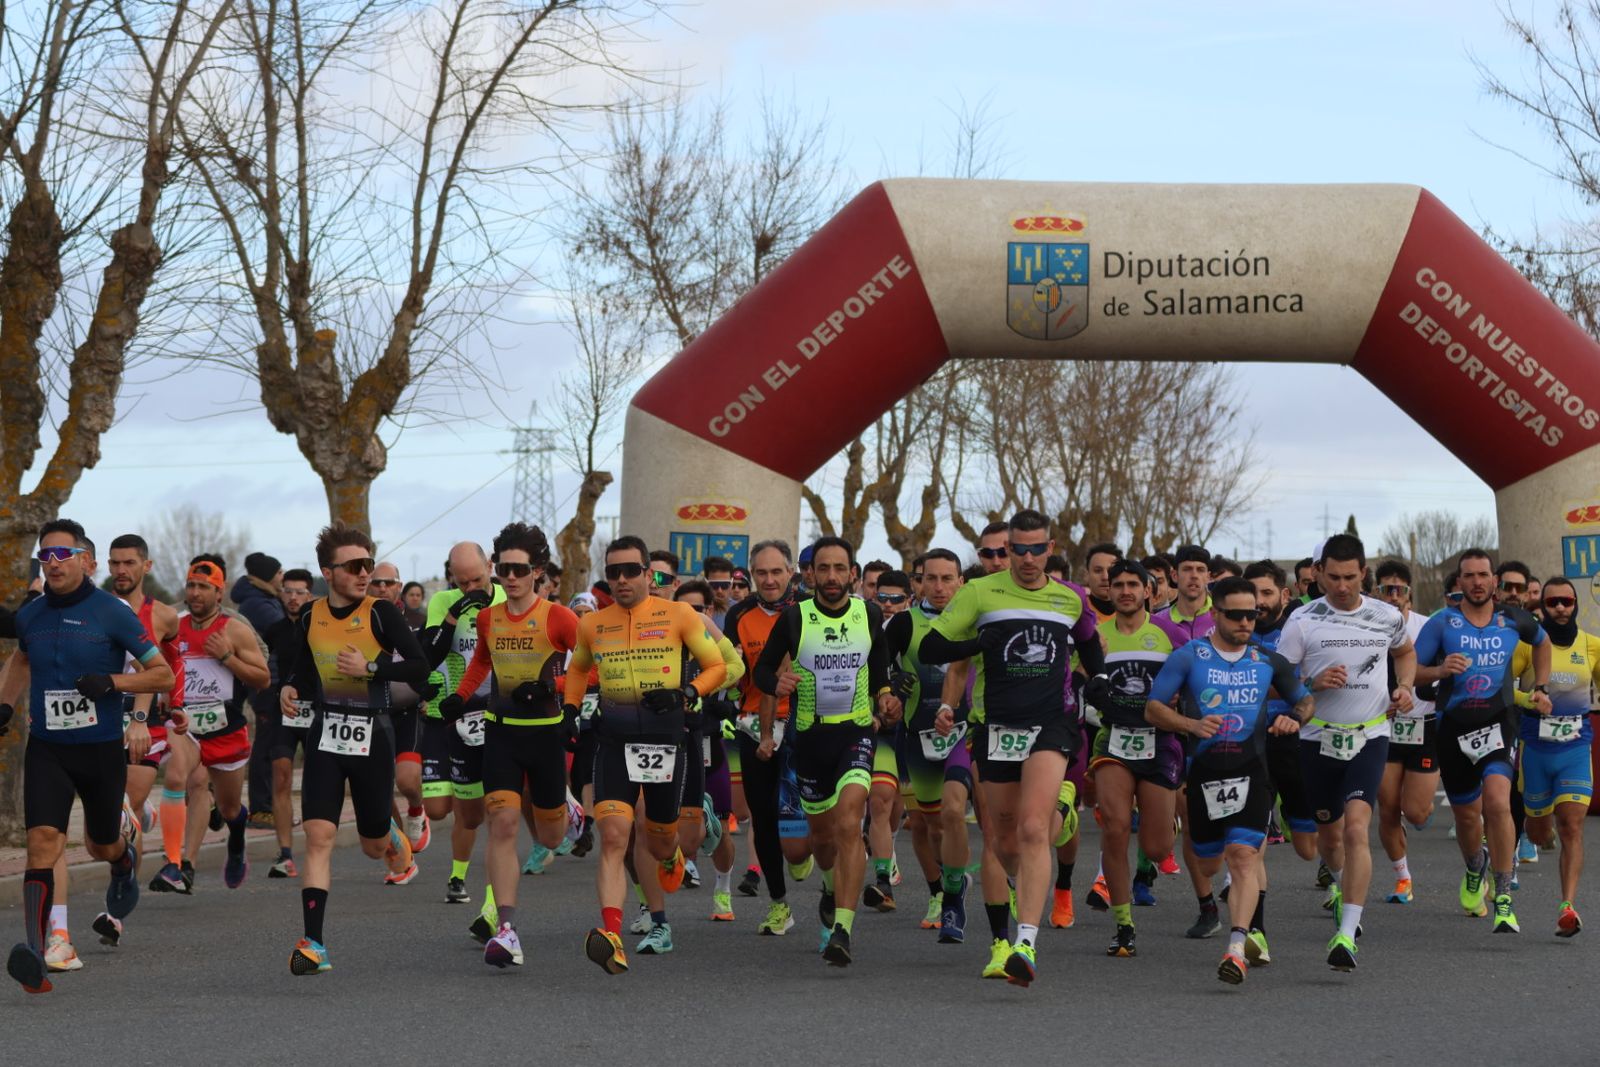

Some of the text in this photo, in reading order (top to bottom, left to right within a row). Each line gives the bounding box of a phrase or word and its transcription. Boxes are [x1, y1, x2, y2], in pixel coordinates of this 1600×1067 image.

[1103, 248, 1270, 281] Diputación
[1103, 289, 1304, 317] de Salamanca
[708, 253, 912, 438] CON EL DEPORTE
[1415, 267, 1599, 431] CON NUESTROS
[1398, 301, 1564, 448] DEPORTISTAS
[496, 636, 533, 650] ESTÉVEZ
[1321, 639, 1349, 649] CARRERA
[1461, 635, 1502, 650] PINTO
[602, 649, 635, 658] ESCUELA
[814, 653, 861, 670] RODRIGUEZ
[1477, 651, 1505, 665] MSC
[1207, 668, 1258, 686] FERMOSELLE
[1227, 688, 1258, 704] MSC
[51, 698, 90, 717] 104
[193, 711, 217, 727] 79
[328, 723, 366, 743] 106
[1394, 722, 1415, 736] 97
[1550, 723, 1574, 737] 76
[932, 733, 958, 752] 94
[1000, 734, 1029, 752] 95
[1119, 735, 1145, 752] 75
[1331, 734, 1354, 751] 81
[1471, 733, 1490, 750] 67
[637, 753, 664, 770] 32
[1216, 786, 1239, 804] 44
